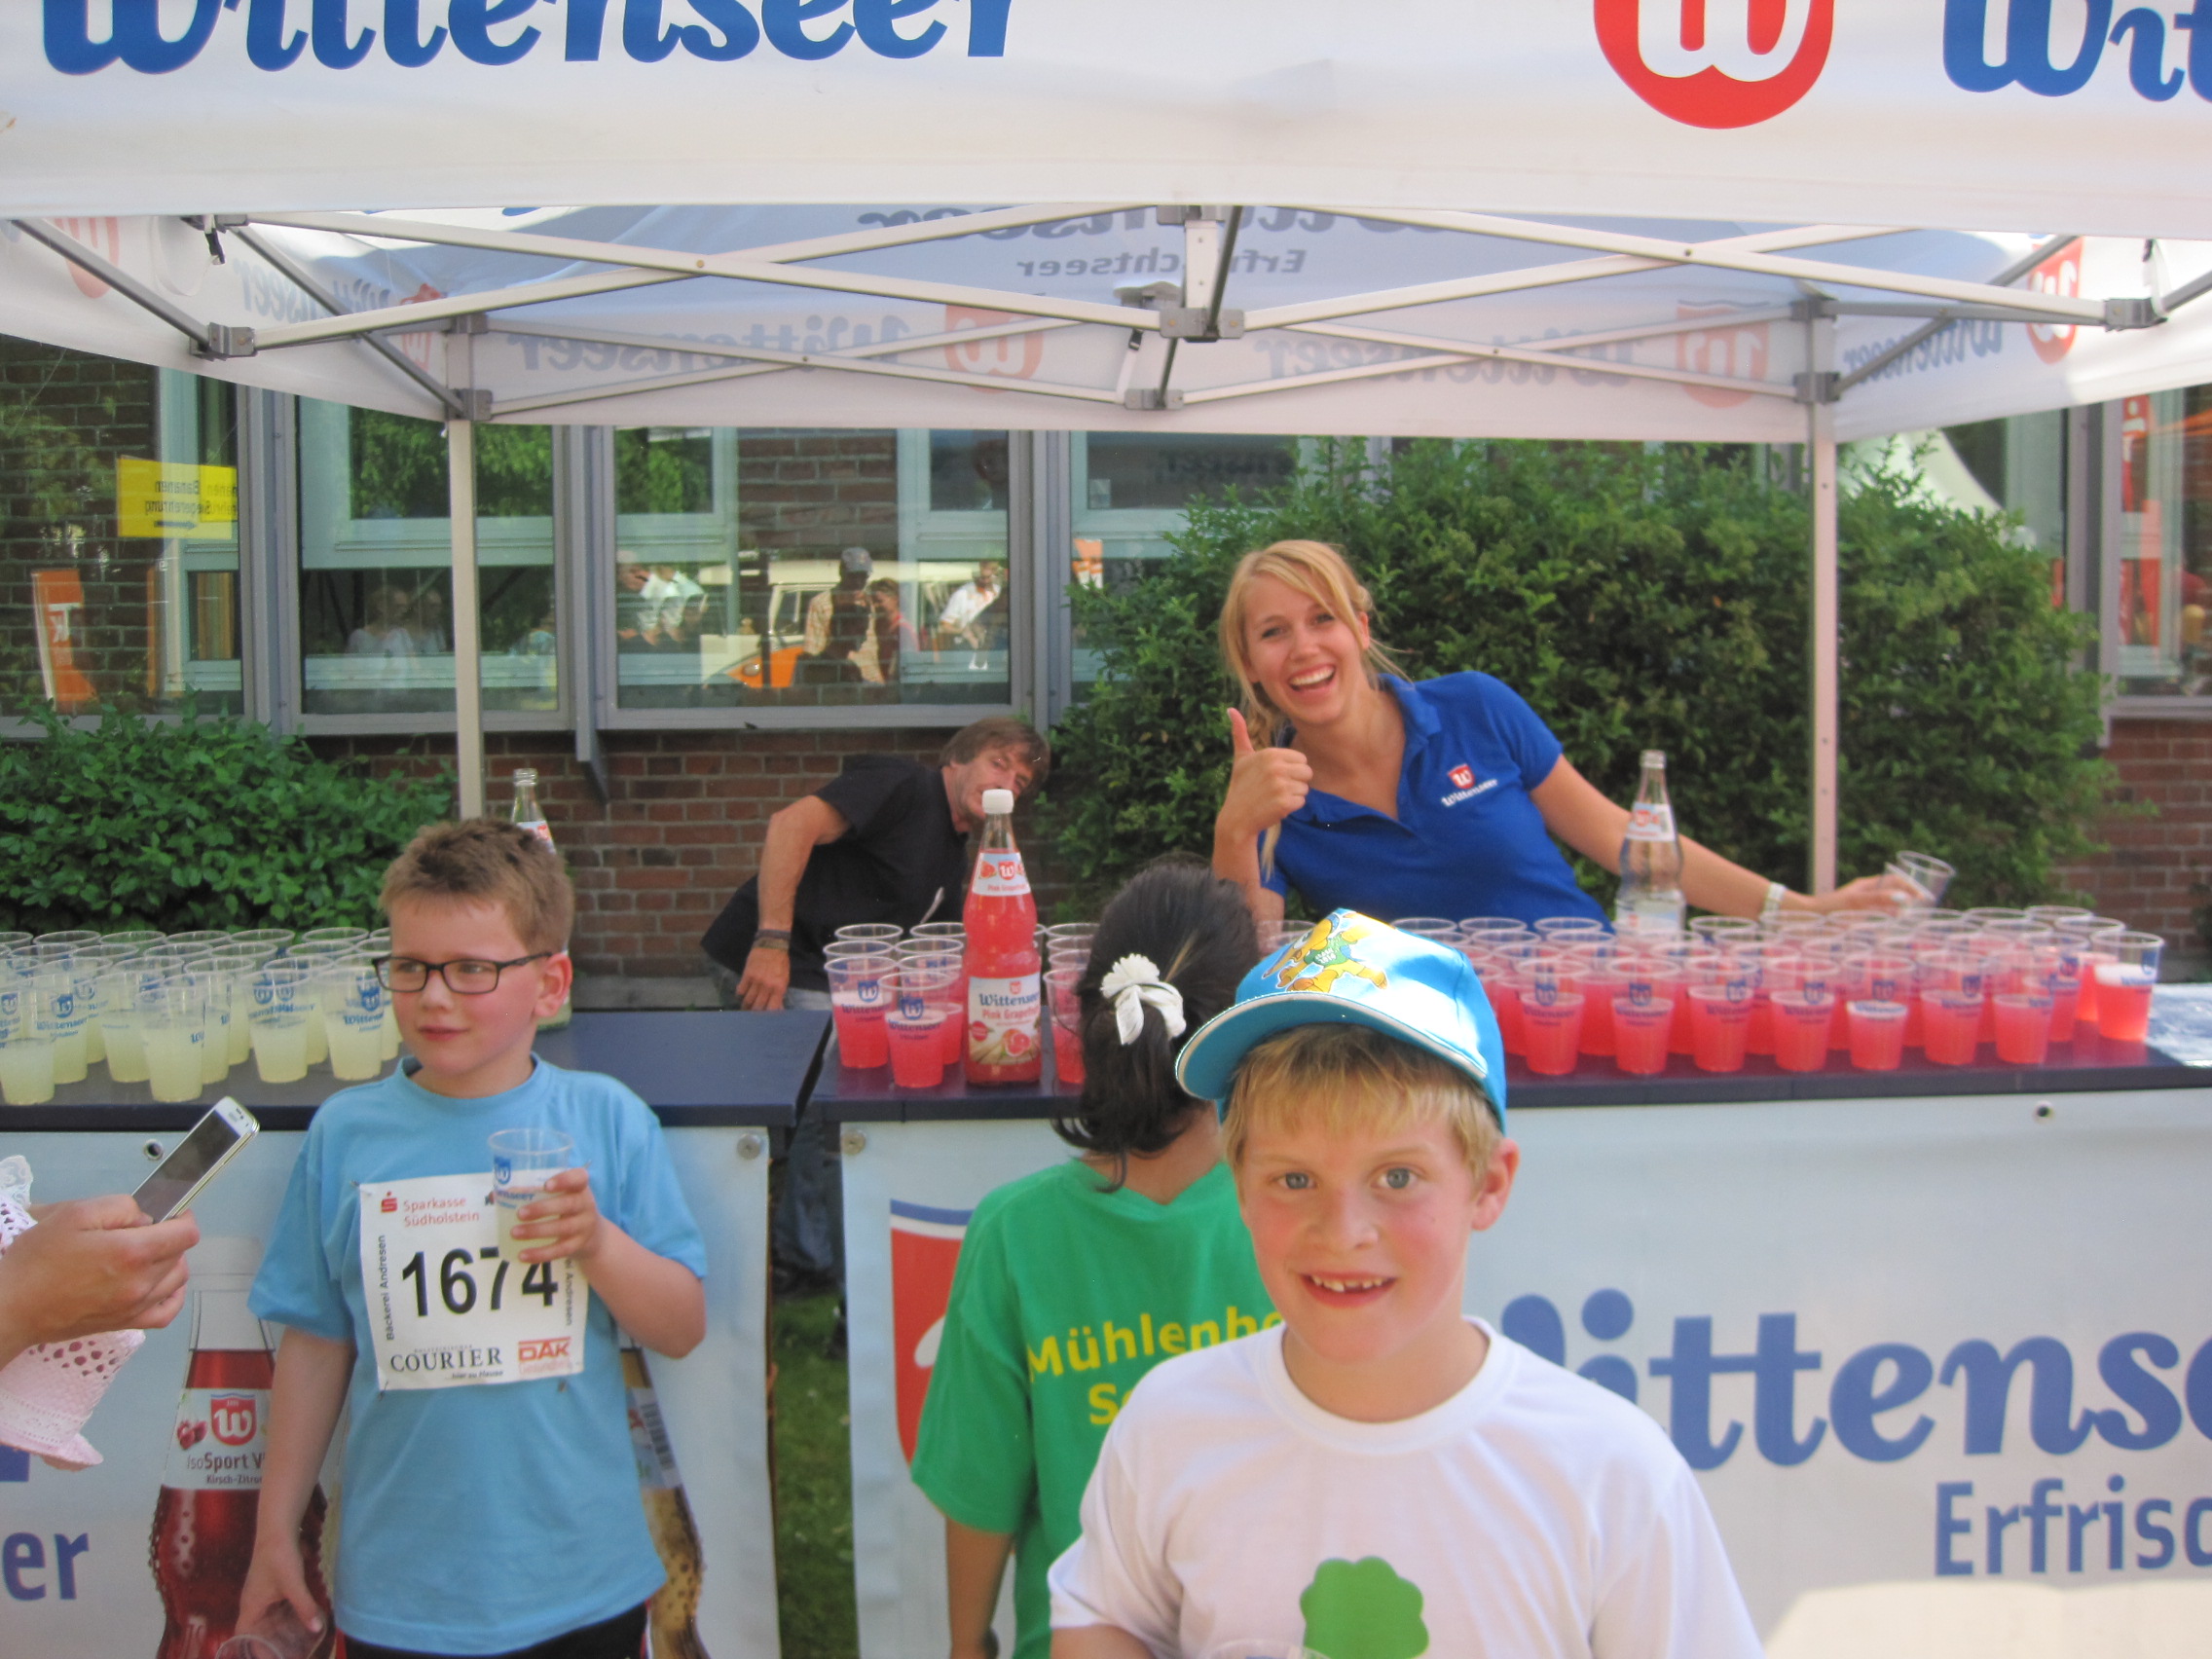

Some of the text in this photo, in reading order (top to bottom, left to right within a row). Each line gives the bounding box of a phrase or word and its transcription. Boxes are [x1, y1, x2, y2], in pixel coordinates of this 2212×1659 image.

[403, 1197, 467, 1213] Sparkasse
[404, 1210, 480, 1228] Südholstein
[402, 1246, 559, 1317] 1674
[390, 1347, 503, 1374] COURIER
[518, 1337, 571, 1362] DAK
